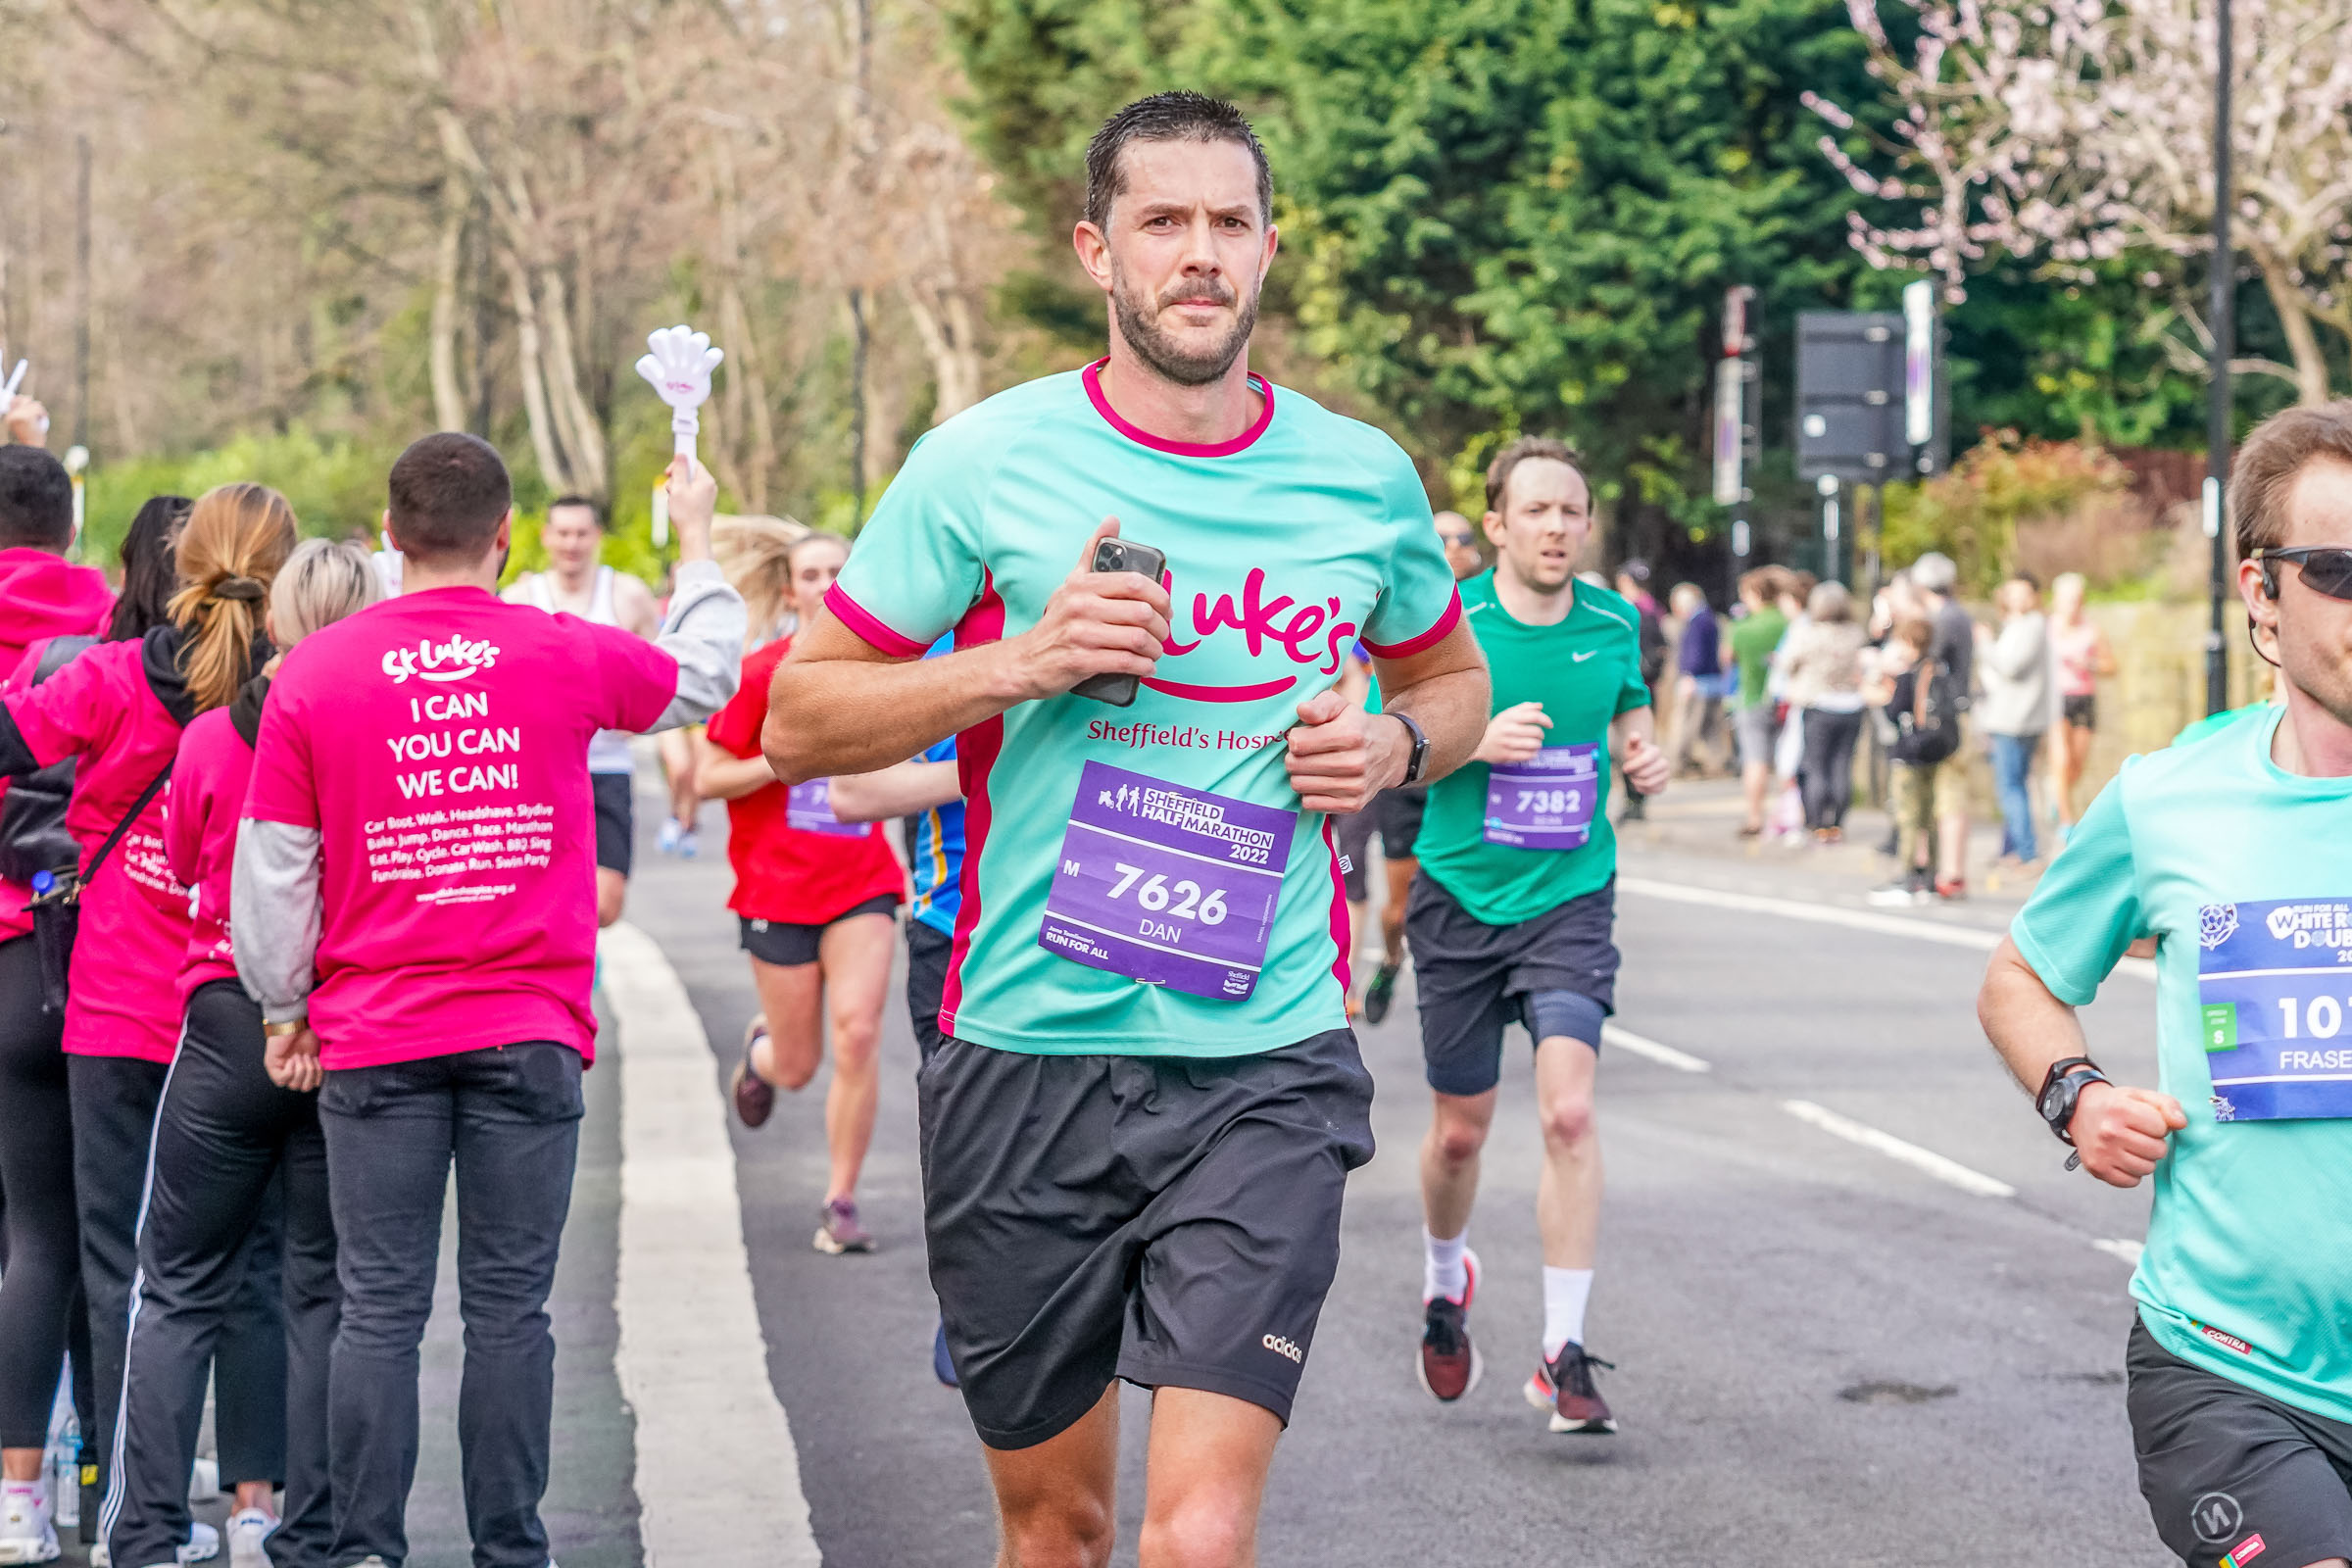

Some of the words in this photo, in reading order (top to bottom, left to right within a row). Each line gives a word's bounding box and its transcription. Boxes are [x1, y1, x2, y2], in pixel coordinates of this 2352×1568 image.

[381, 648, 418, 684] St
[419, 633, 501, 669] Luke's
[410, 698, 420, 723] I
[424, 691, 488, 721] CAN
[386, 730, 453, 763] YOU
[457, 726, 520, 756] CAN
[1087, 720, 1209, 751] Sheffield's
[396, 768, 444, 800] WE
[448, 763, 519, 794] CAN!
[1146, 790, 1221, 820] SHEFFIELD
[1515, 789, 1582, 814] 7382
[364, 820, 386, 835] Car
[415, 809, 450, 826] Walk.
[449, 805, 516, 822] Headshave.
[431, 825, 472, 843] Dance.
[472, 823, 505, 838] Race.
[1141, 804, 1184, 826] HALF
[1184, 816, 1272, 848] MARATHON
[451, 842, 470, 857] Car
[1229, 844, 1270, 865] 2022
[1062, 859, 1080, 878] M
[1106, 862, 1228, 926] 7626
[2274, 911, 2332, 929] WHITE
[2313, 904, 2332, 913] FOR
[2332, 903, 2350, 912] ALL
[1046, 931, 1069, 947] RUN
[1068, 939, 1090, 954] FOR
[1089, 947, 1109, 960] ALL
[1138, 918, 1183, 944] DAN
[2278, 995, 2352, 1040] 10
[2279, 1050, 2352, 1070] FRASE
[1262, 1333, 1303, 1364] adidas
[2206, 1329, 2246, 1351] CONTRA
